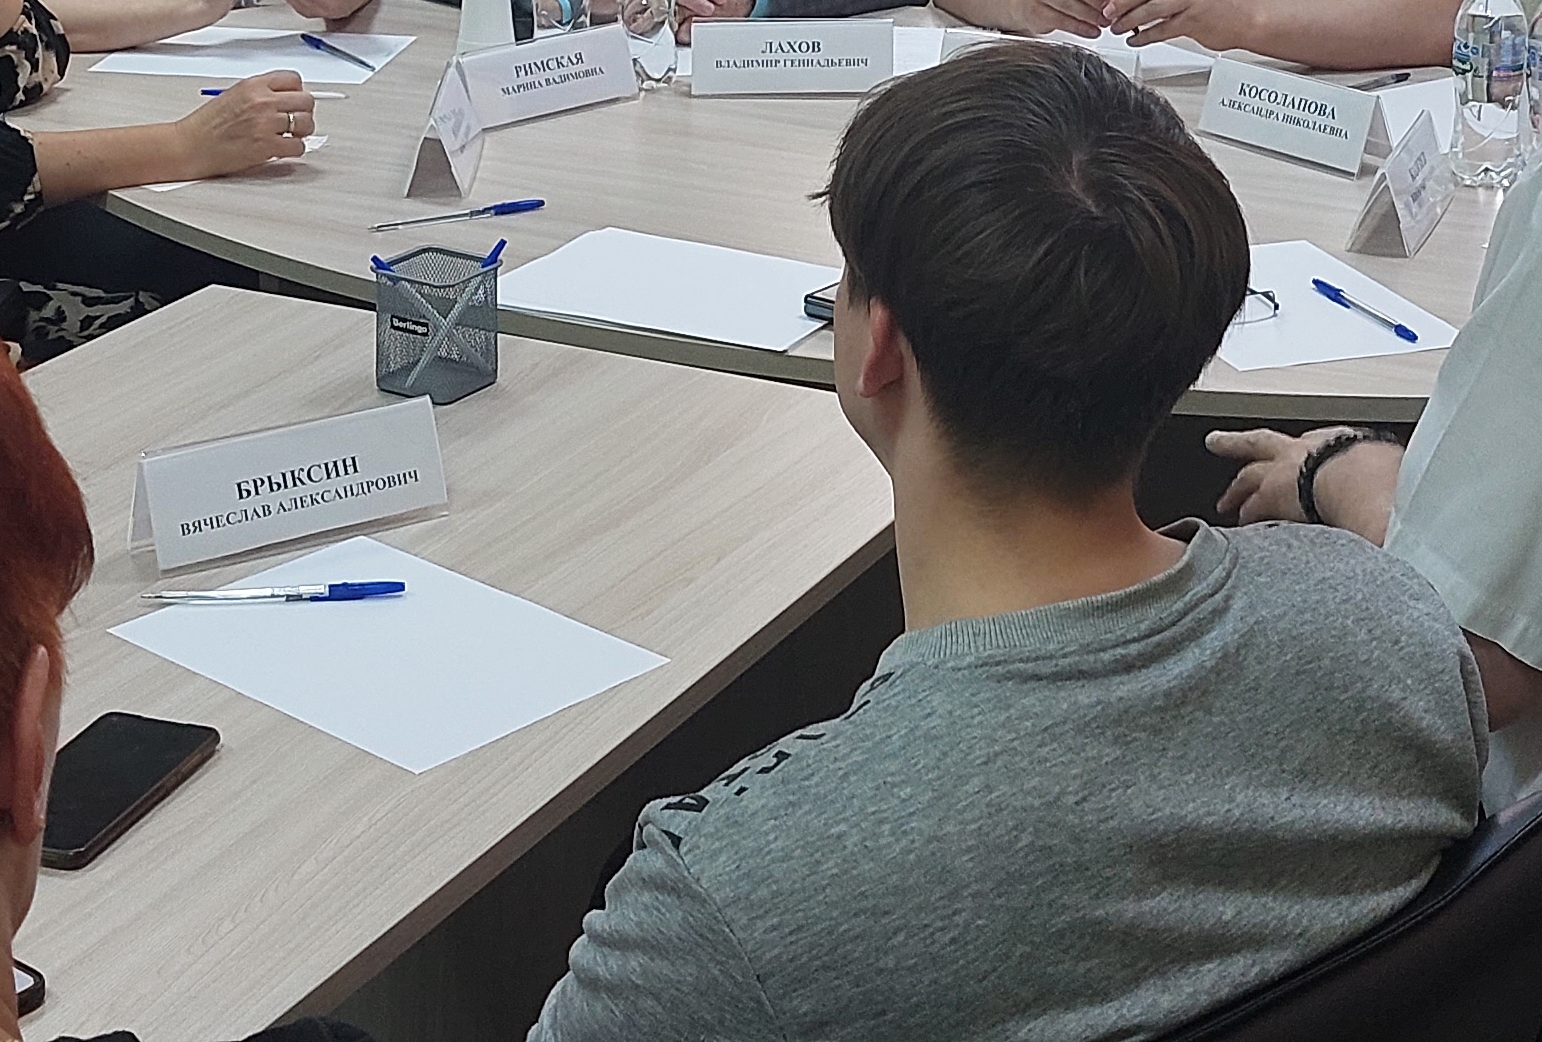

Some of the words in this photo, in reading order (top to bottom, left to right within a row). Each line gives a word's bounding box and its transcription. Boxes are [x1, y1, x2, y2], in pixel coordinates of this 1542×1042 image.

[513, 51, 585, 79] РИМСКАЯ
[715, 59, 781, 69] ВЛАДИМИР
[783, 57, 868, 68] ГЕННАДЬЕВИЧ
[761, 41, 822, 54] ЛАХОВ
[501, 79, 544, 97] МАРИНА
[545, 66, 605, 87] ВАДИМОВНА
[1218, 97, 1280, 121] АЛЕКСАНДРА
[1281, 112, 1349, 140] НИКОЛАЕВНА
[1238, 82, 1337, 121] КОСОЛАПОВА
[235, 455, 360, 501] БРЫКСИН
[180, 504, 273, 537] ВЯЧЕСЛАВ
[276, 469, 420, 515] АЛЕКСАНДРОВИЧ
